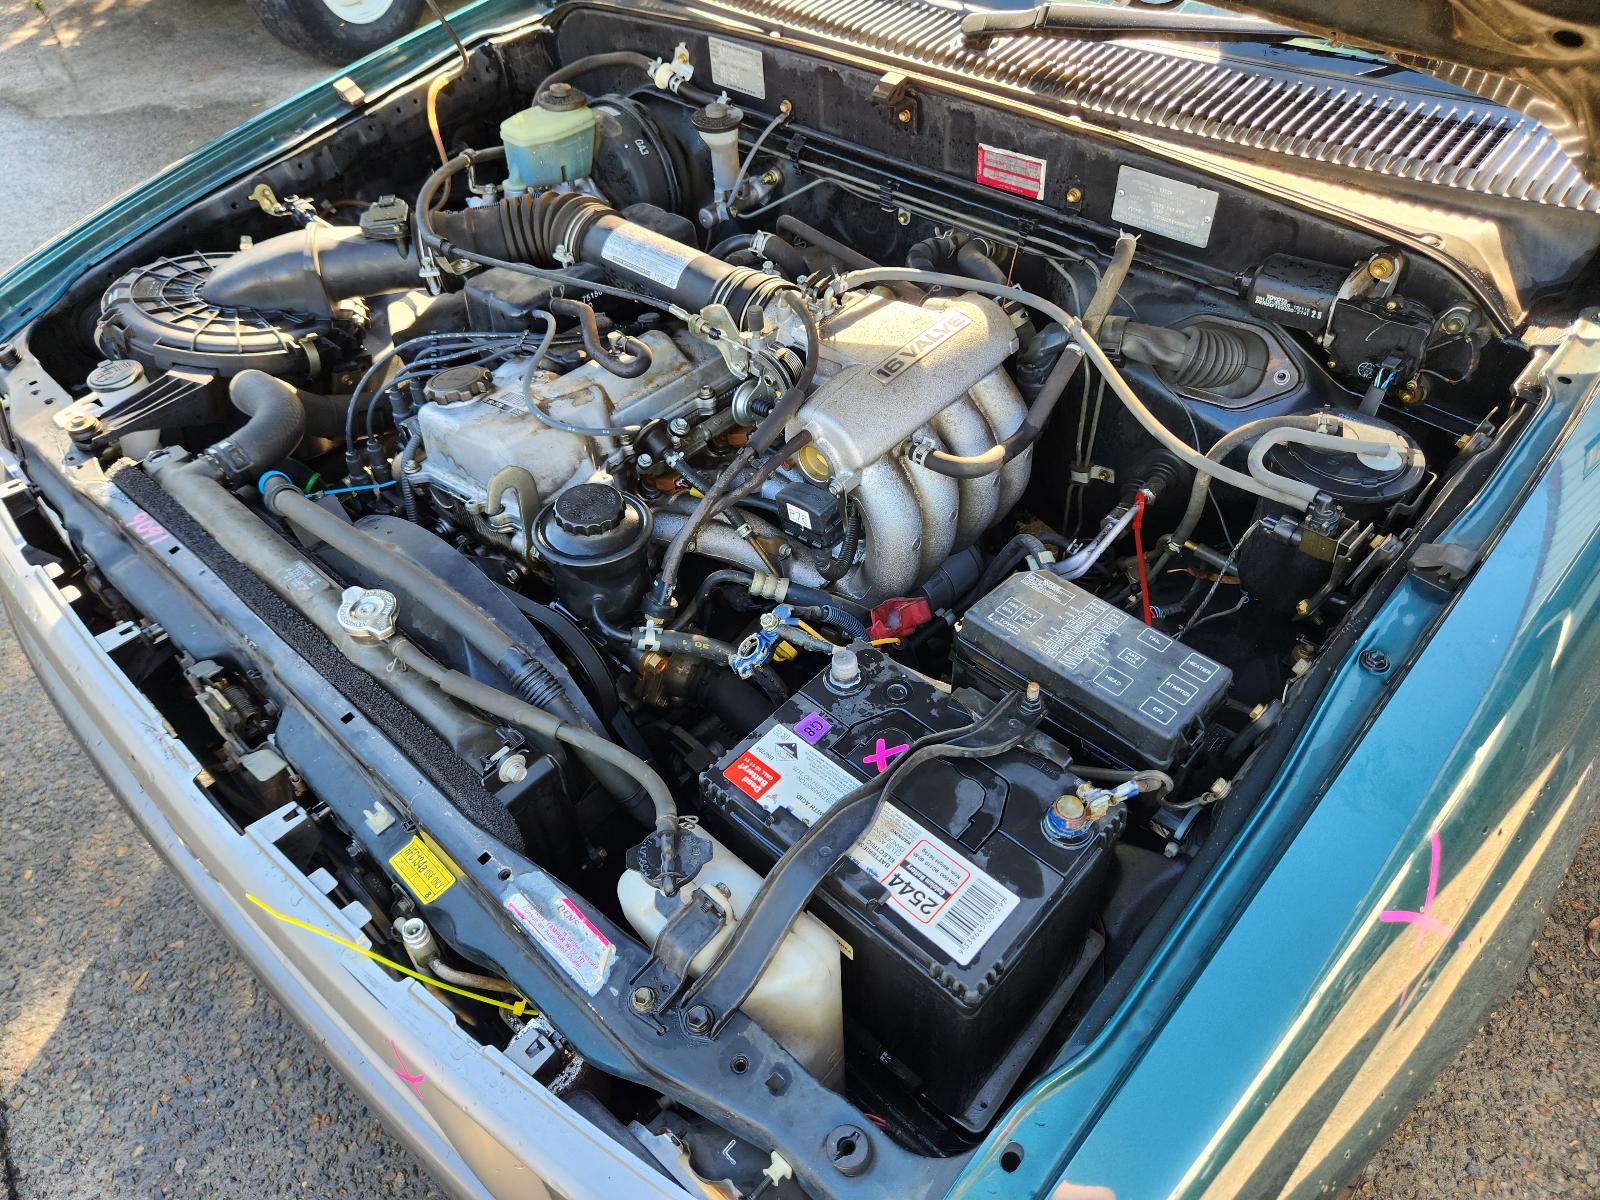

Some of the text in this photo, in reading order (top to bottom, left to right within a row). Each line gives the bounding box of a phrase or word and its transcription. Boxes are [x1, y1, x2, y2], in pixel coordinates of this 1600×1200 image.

[877, 316, 965, 377] 16 VALVE
[997, 617, 1023, 633] TOYOTA
[1185, 659, 1212, 675] HEATER
[1103, 674, 1122, 686] HEAD
[1164, 681, 1191, 698] STARTER
[736, 760, 770, 787] Battery?
[759, 769, 774, 780] CALL
[740, 775, 762, 793] Dead
[865, 837, 895, 864] ELECTRIC
[888, 872, 938, 915] 2544
